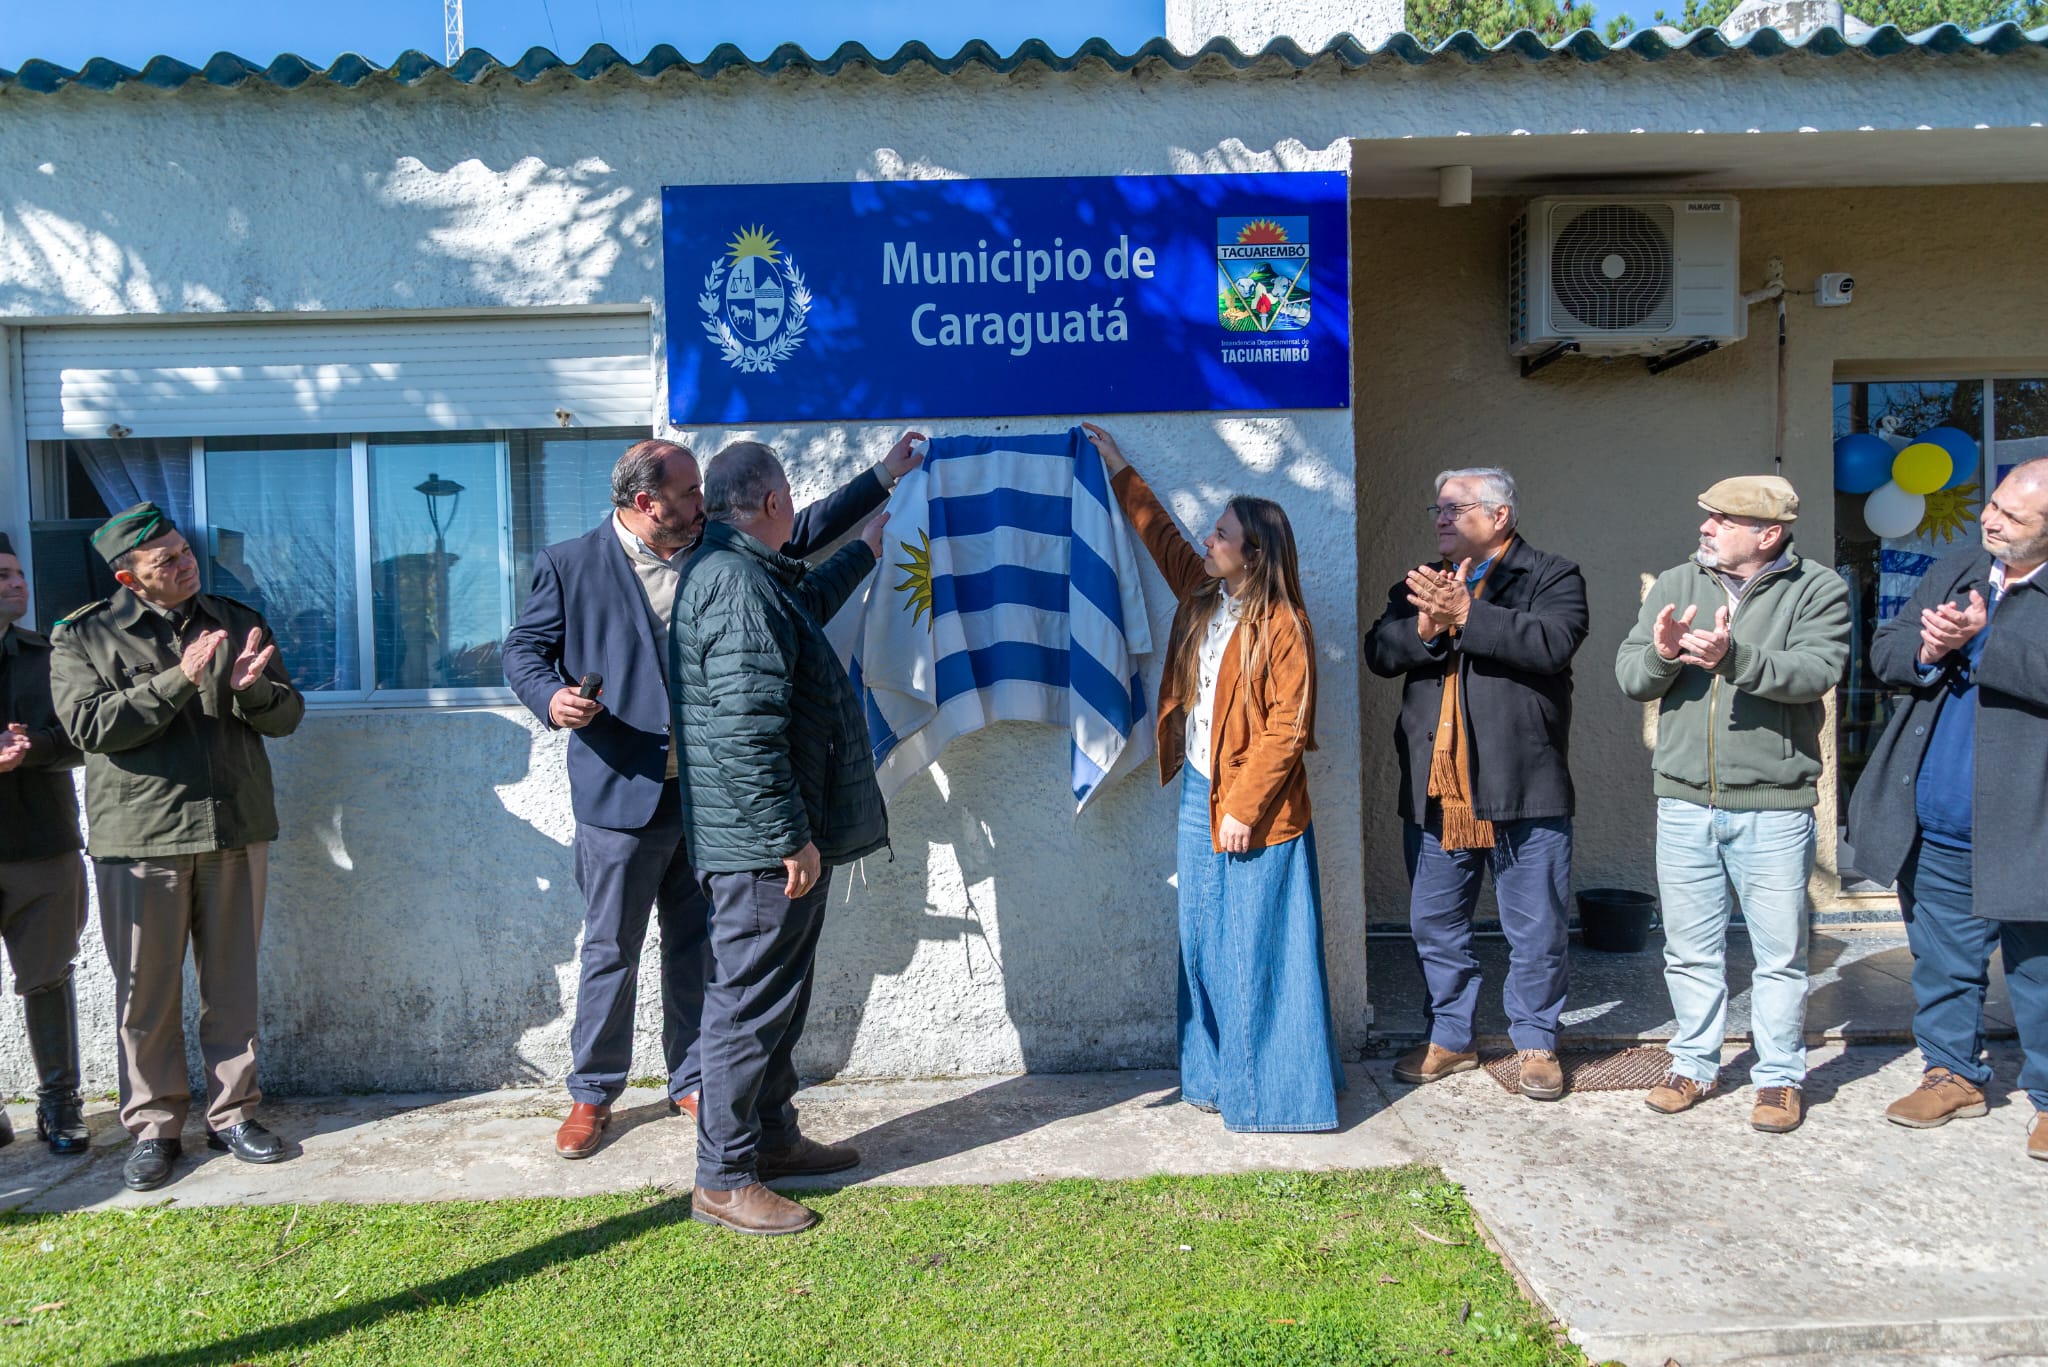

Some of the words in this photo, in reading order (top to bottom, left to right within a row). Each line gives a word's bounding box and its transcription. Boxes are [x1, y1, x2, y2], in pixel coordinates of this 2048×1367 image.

[882, 237, 1092, 294] Municipio
[1104, 234, 1156, 280] de
[1221, 244, 1306, 258] TACUAREMBÓ
[911, 297, 1129, 356] Caraguatá
[1221, 344, 1310, 363] TACUAREMBÓ
